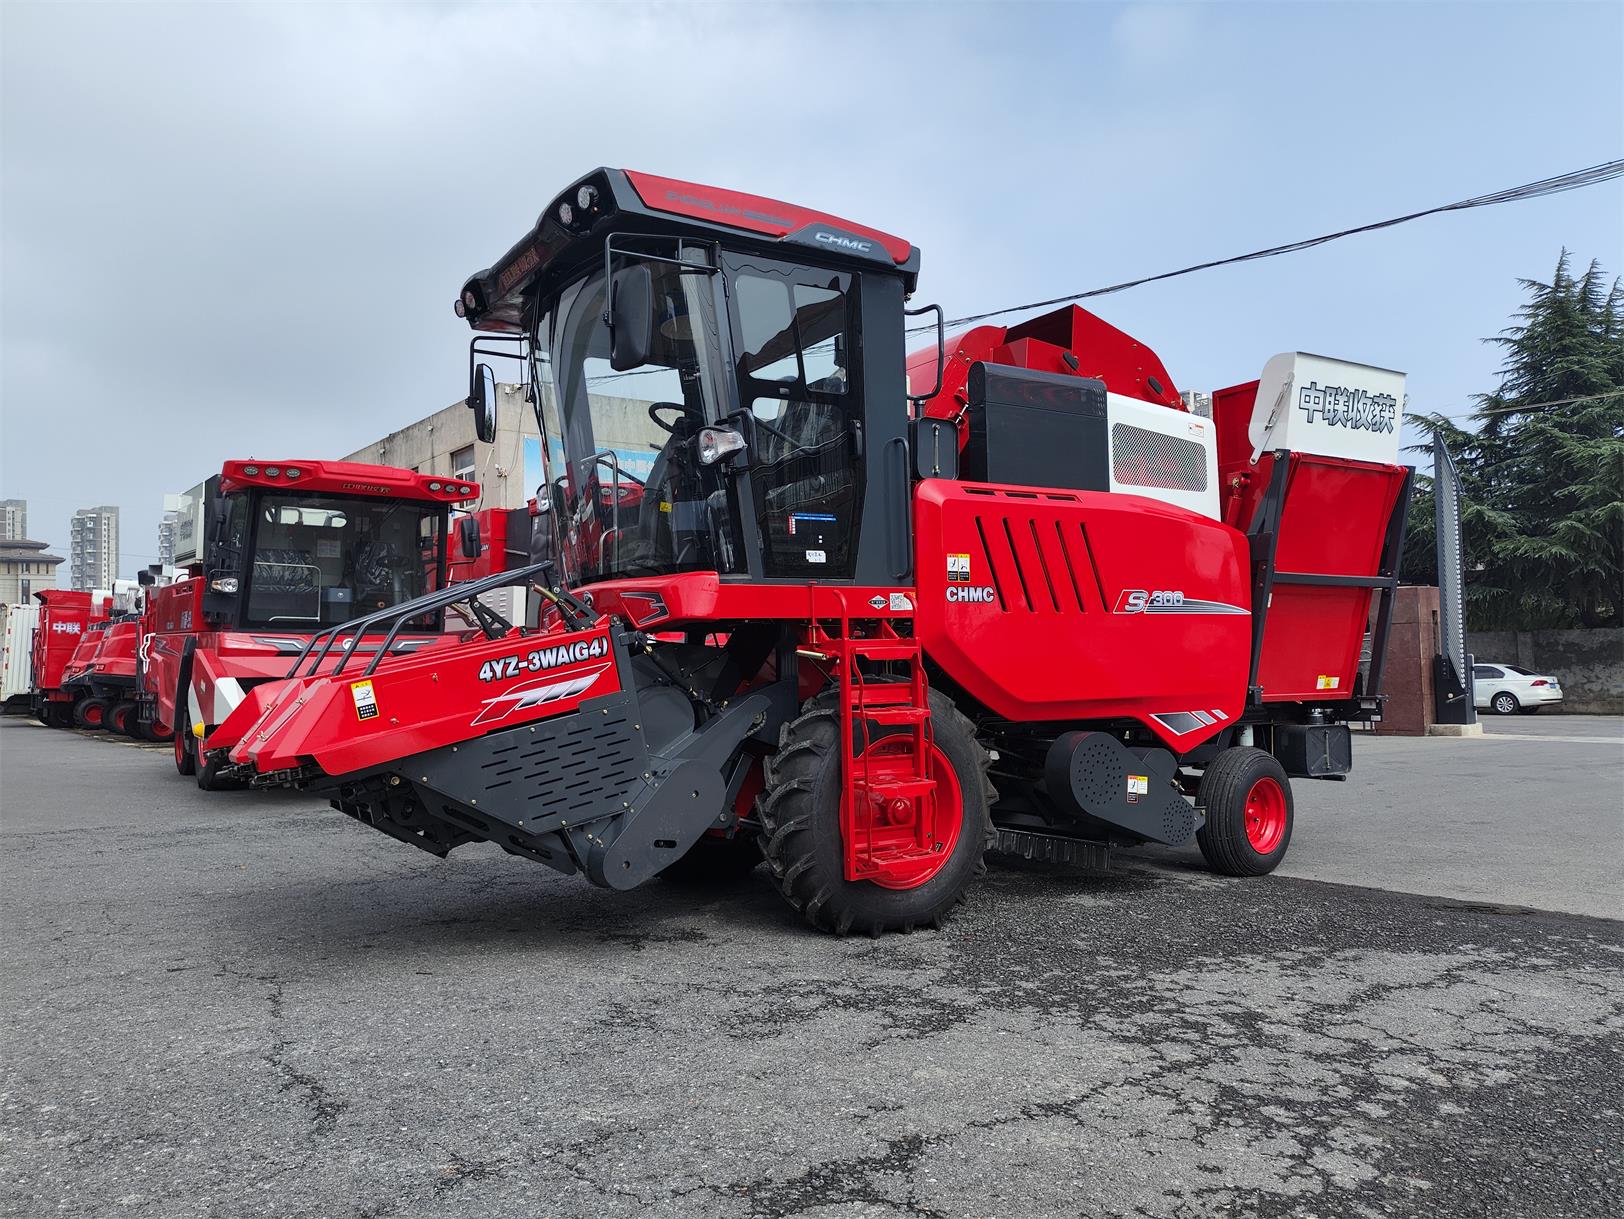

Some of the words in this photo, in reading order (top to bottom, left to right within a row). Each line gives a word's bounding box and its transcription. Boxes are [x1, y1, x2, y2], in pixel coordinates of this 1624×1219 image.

[814, 230, 872, 253] CHMC
[1298, 381, 1397, 434] 中联收获
[946, 586, 995, 603] CHMC
[1151, 590, 1184, 606] 300
[52, 621, 81, 635] 中联
[478, 636, 609, 683] 4YZ-3WA(G4)
